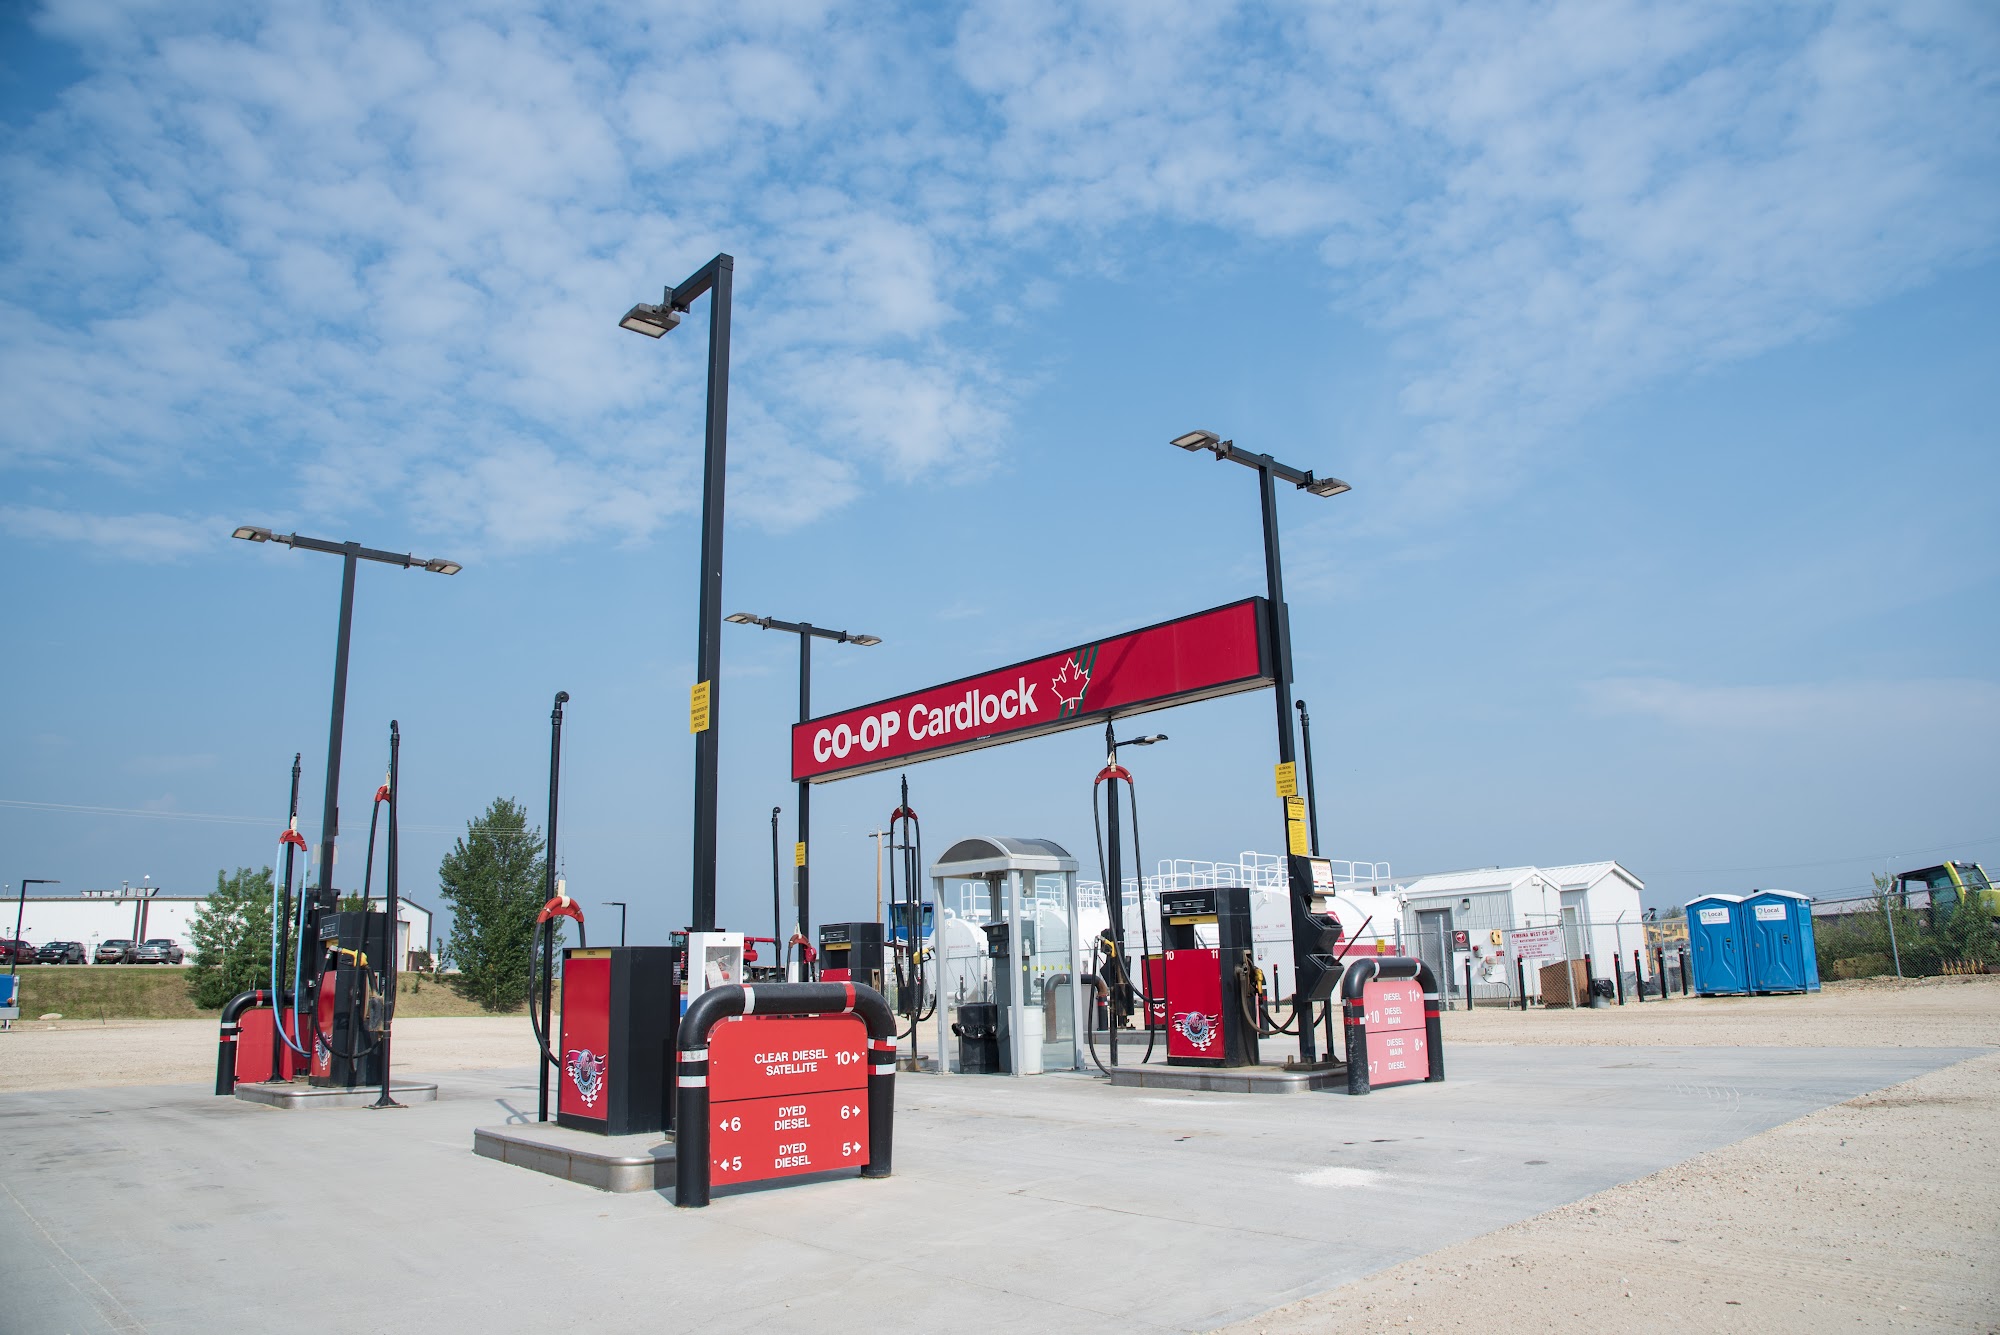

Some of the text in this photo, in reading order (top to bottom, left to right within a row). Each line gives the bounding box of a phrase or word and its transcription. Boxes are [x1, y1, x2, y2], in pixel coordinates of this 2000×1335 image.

[813, 676, 1039, 763] CO-OP Cardlock
[1166, 951, 1174, 960] 10
[1211, 950, 1218, 959] 11
[1384, 993, 1401, 1001] DIESEL
[1408, 990, 1417, 1002] 11
[1370, 1010, 1380, 1023] 10
[1385, 1007, 1402, 1015] DIESEL
[1387, 1038, 1404, 1046] DIESEL
[1415, 1039, 1420, 1051] 8
[754, 1049, 828, 1064] CLEAR DIESEL
[835, 1051, 850, 1065] 10
[1390, 1048, 1402, 1056] MAIN
[766, 1062, 817, 1076] SATELLITE
[1374, 1061, 1378, 1074] 7
[1388, 1061, 1406, 1070] DIESEL
[778, 1105, 806, 1118] DYED
[840, 1105, 850, 1119] 6
[730, 1117, 741, 1132] 6
[774, 1118, 810, 1131] DIESEL
[779, 1142, 806, 1155] DYED
[842, 1142, 851, 1156] 5
[732, 1156, 742, 1171] 5
[775, 1155, 811, 1169] DIESEL
